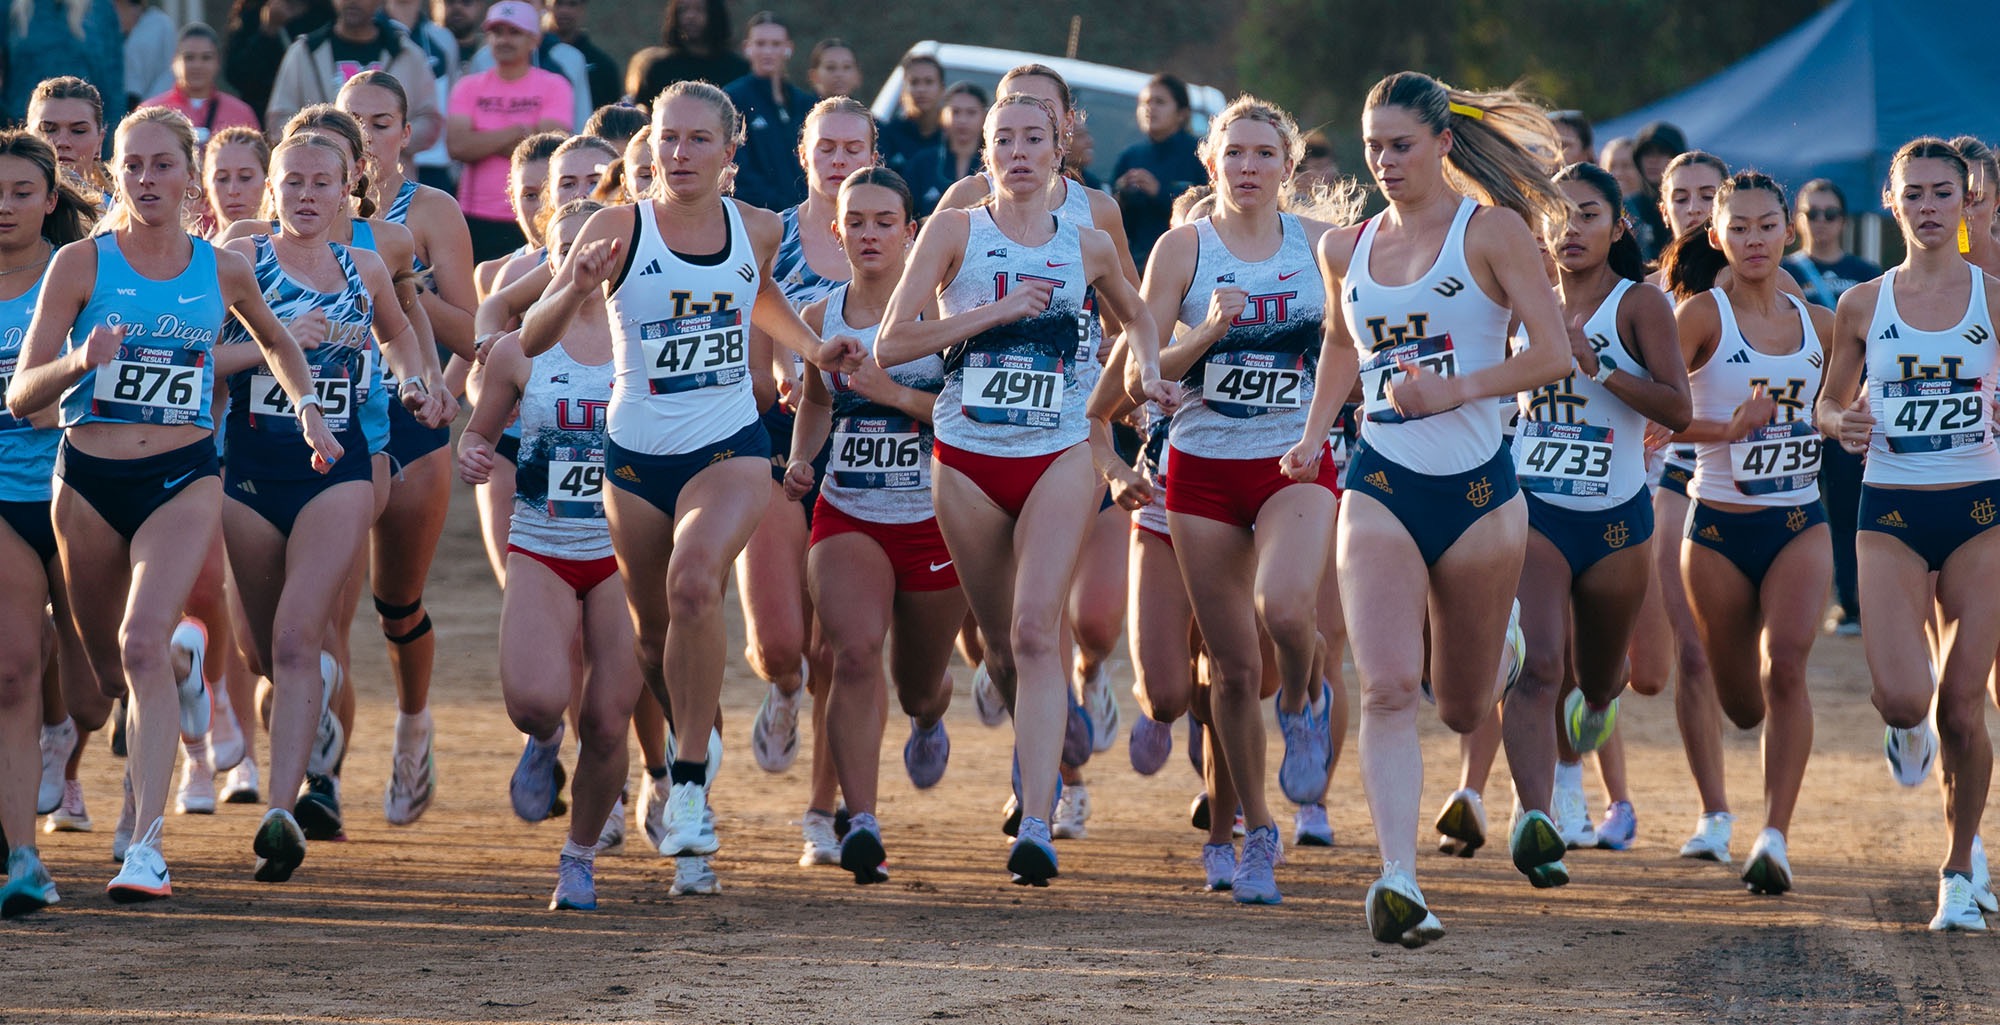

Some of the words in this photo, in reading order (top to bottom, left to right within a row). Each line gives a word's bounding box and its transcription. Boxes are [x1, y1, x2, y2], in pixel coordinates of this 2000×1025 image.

[681, 316, 711, 326] FINISHED
[106, 312, 147, 338] San
[151, 313, 213, 350] Diego
[680, 323, 711, 333] RESULTS
[143, 347, 173, 357] FINISHED
[656, 329, 743, 373] 4738
[140, 356, 171, 364] RESULTS
[1004, 354, 1033, 363] FINISHED
[1246, 353, 1275, 361] FINISHED
[1002, 361, 1032, 370] RESULTS
[1244, 360, 1274, 368] RESULTS
[114, 364, 195, 406] 876
[981, 370, 1056, 409] 4911
[1216, 367, 1300, 404] 4912
[1921, 381, 1952, 389] FINISHED
[1920, 388, 1950, 396] RESULTS
[263, 381, 347, 415] 415
[1894, 395, 1984, 432] 4729
[860, 419, 887, 427] FINISHED
[1553, 424, 1582, 433] FINISHED
[1766, 425, 1792, 434] FINISHED
[1552, 431, 1580, 440] RESULTS
[1765, 431, 1791, 440] RESULTS
[840, 436, 920, 468] 4906
[1742, 438, 1822, 475] 4739
[1526, 441, 1612, 477] 4733
[1363, 474, 1393, 494] adidas
